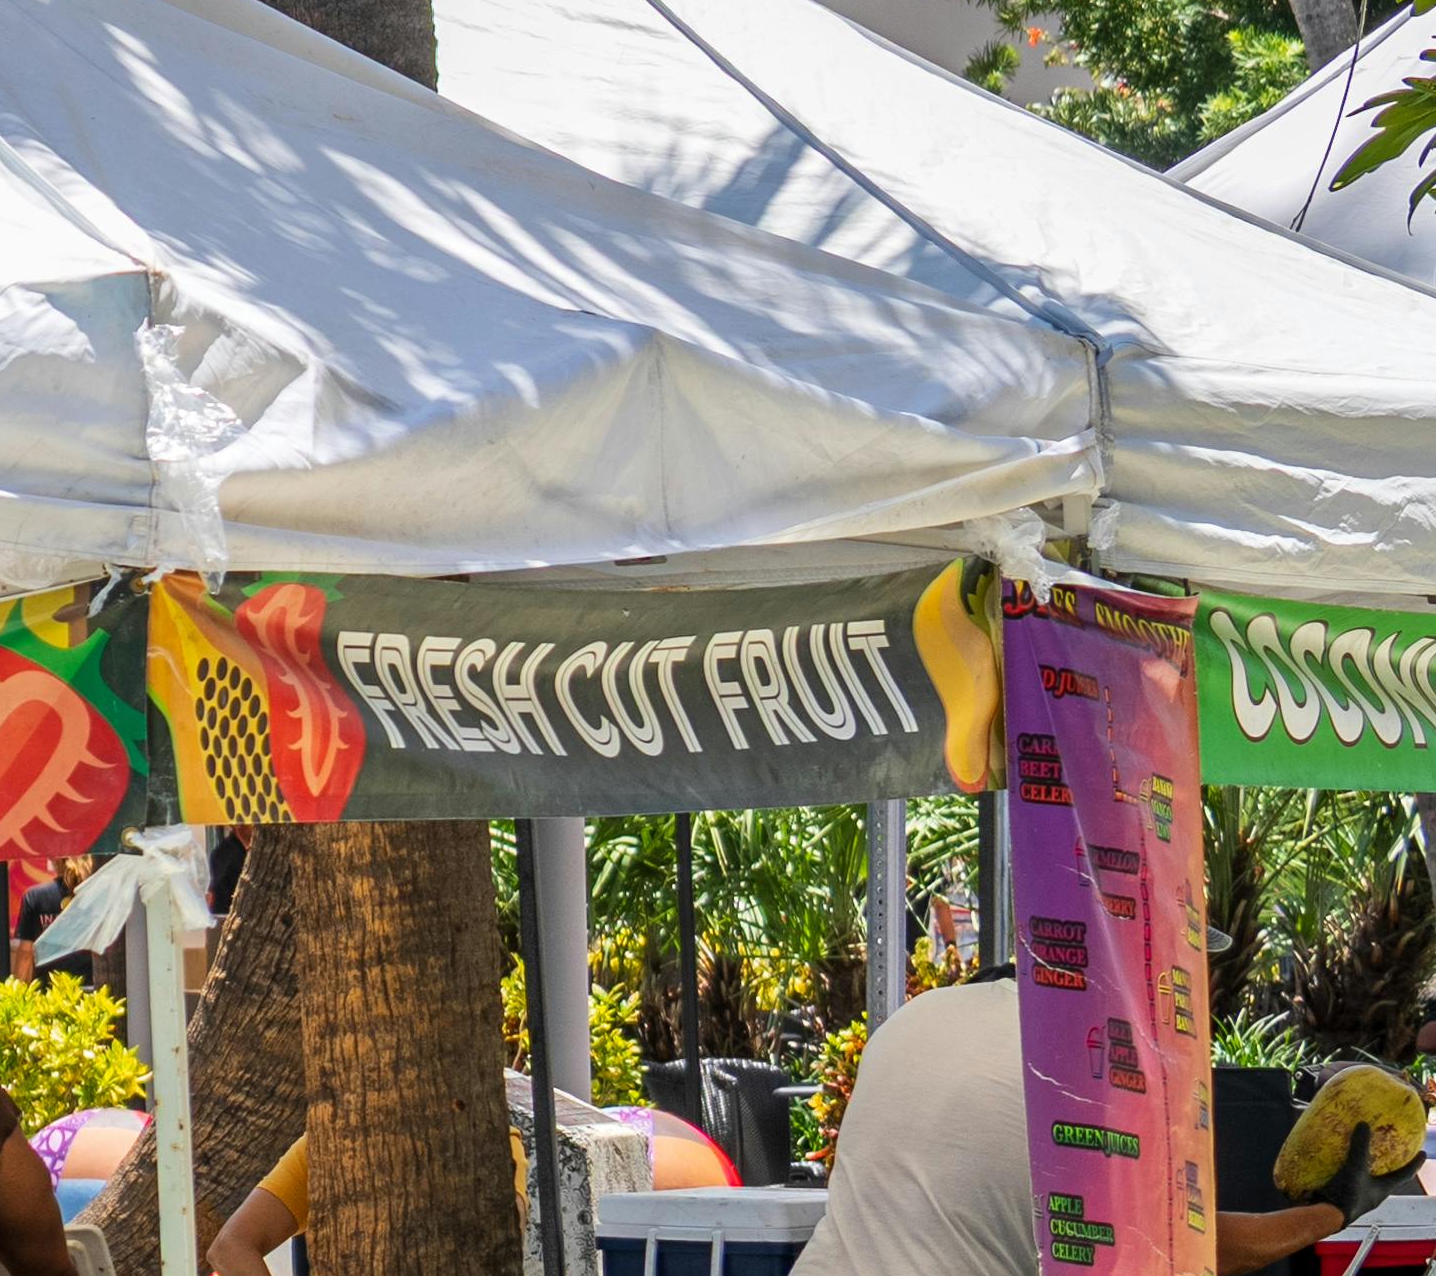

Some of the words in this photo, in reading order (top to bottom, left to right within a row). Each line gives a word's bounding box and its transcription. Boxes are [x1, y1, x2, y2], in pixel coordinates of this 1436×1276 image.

[337, 630, 568, 757] FRESH
[555, 634, 703, 758] CUT
[704, 619, 920, 751] FRUIT
[1209, 607, 1436, 749] COCON
[1020, 760, 1061, 779] BEET
[1021, 783, 1075, 805] CELER
[1032, 919, 1084, 941] CARROT
[1034, 966, 1085, 988] GINGER
[1053, 1124, 1105, 1149] GREEN
[1104, 1131, 1139, 1156] JUICES
[1049, 1195, 1083, 1214] APPLE
[1050, 1218, 1114, 1243] CUCUMBER
[1052, 1242, 1094, 1263] CELERY
